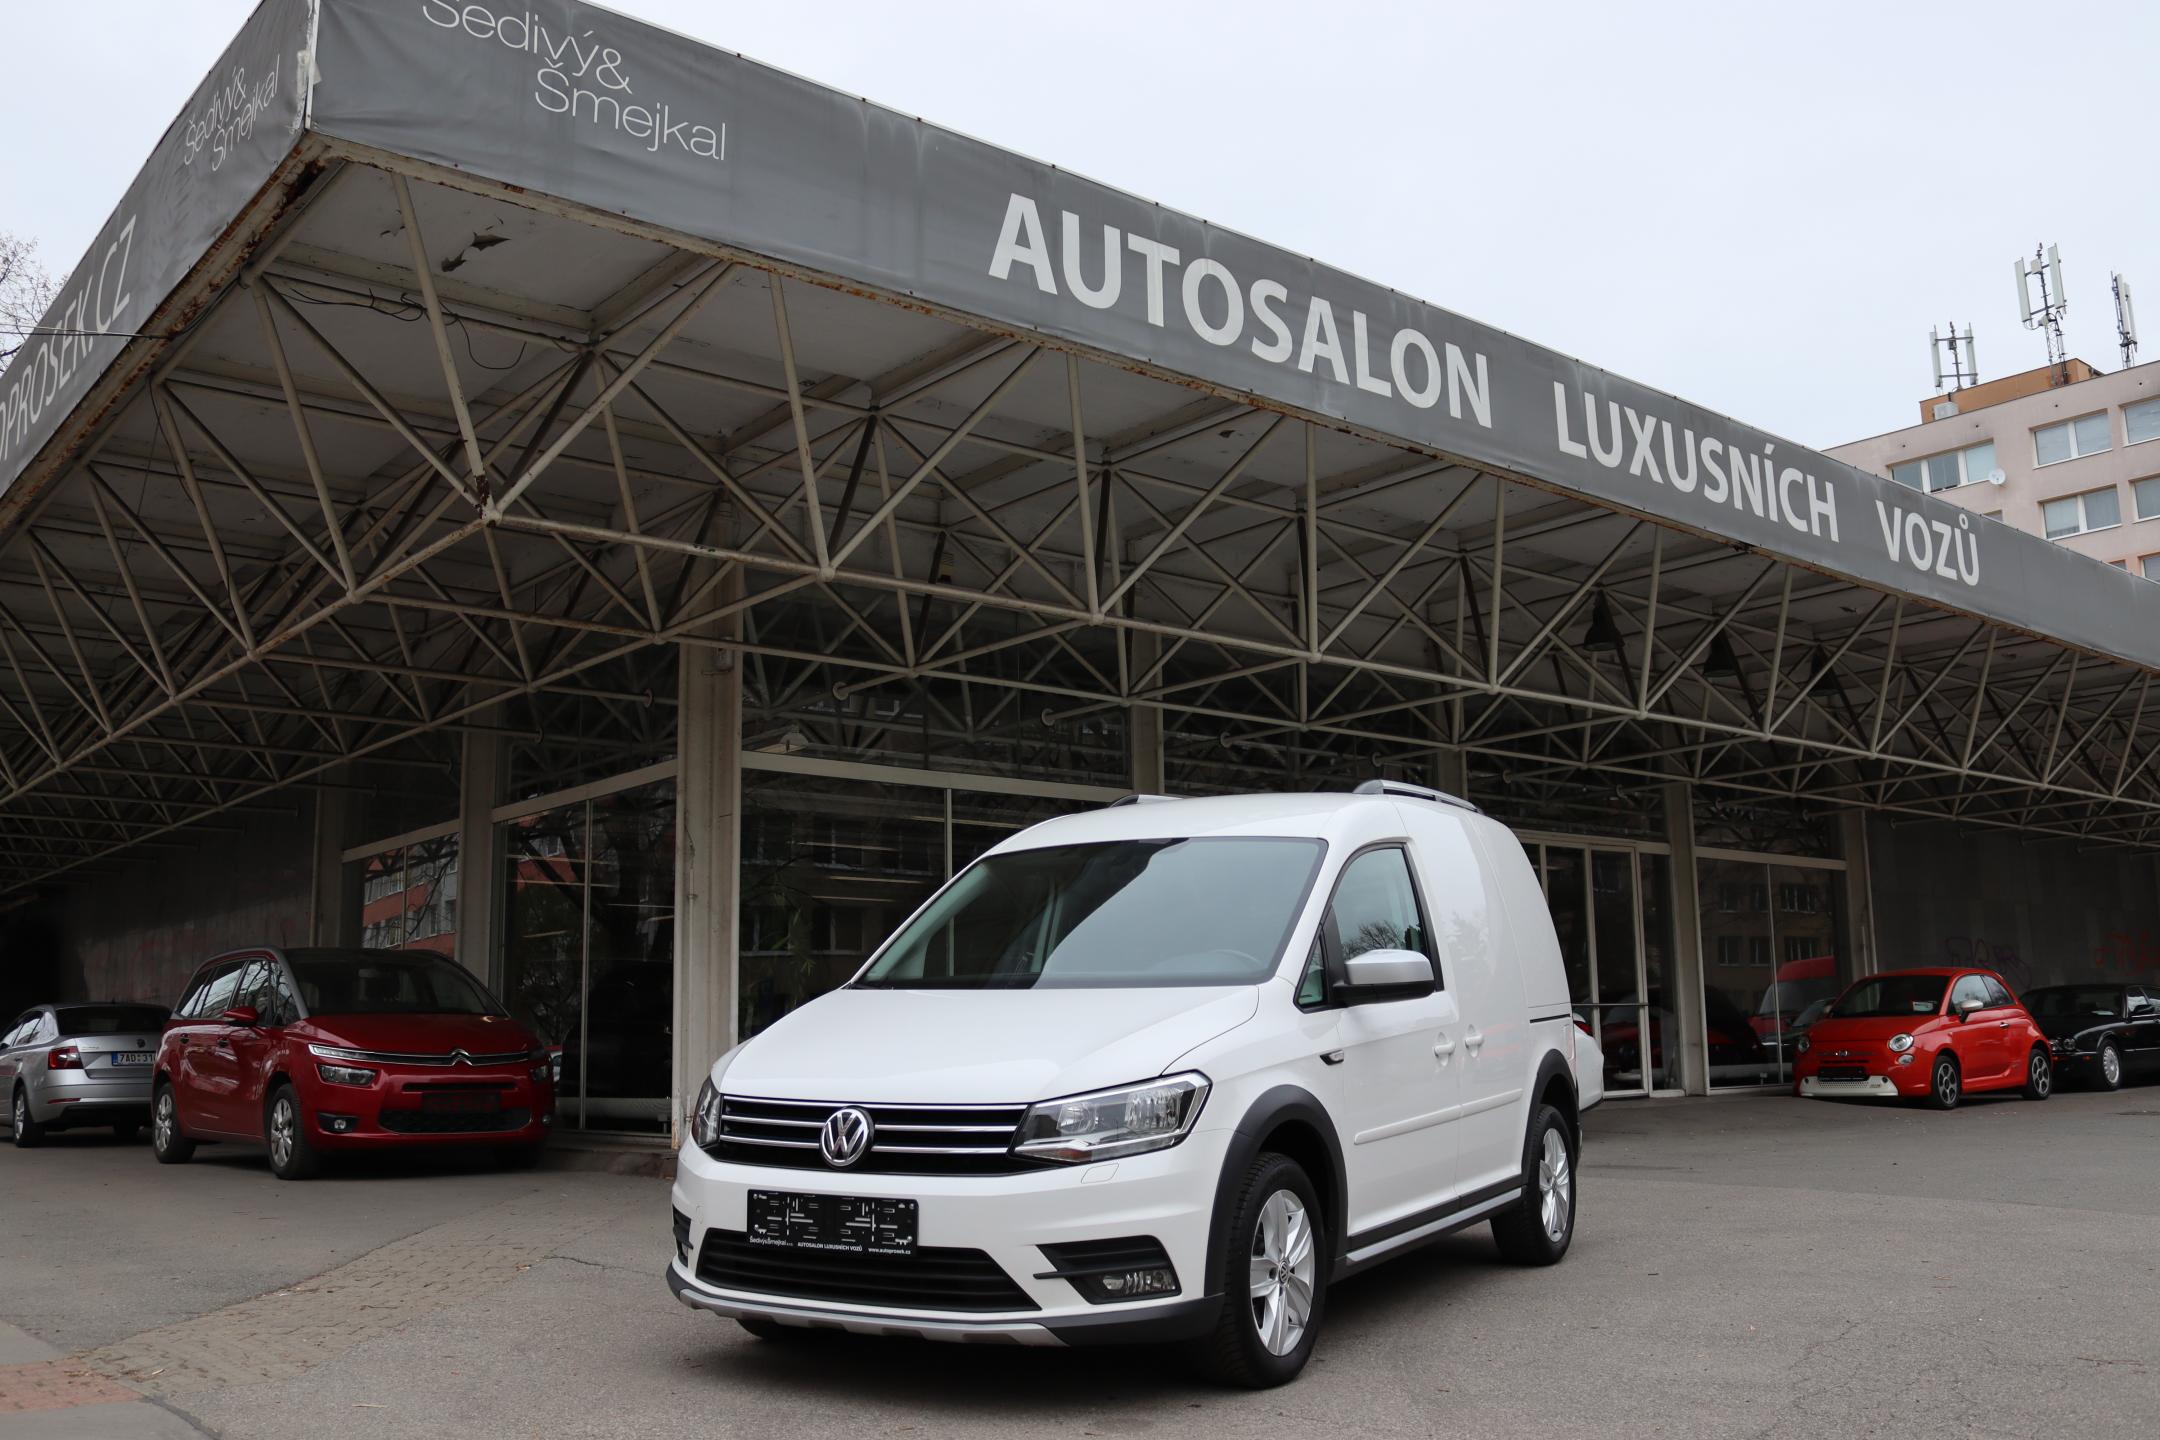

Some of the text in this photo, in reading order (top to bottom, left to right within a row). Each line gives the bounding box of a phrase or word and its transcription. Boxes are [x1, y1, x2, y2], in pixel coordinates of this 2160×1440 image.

[185, 65, 247, 165] Šedivý&
[212, 53, 280, 171] Šmejkal
[535, 57, 726, 161] Šmejkal
[988, 192, 1980, 587] AUTOSALON LUXUSNÍCH VOZŮ
